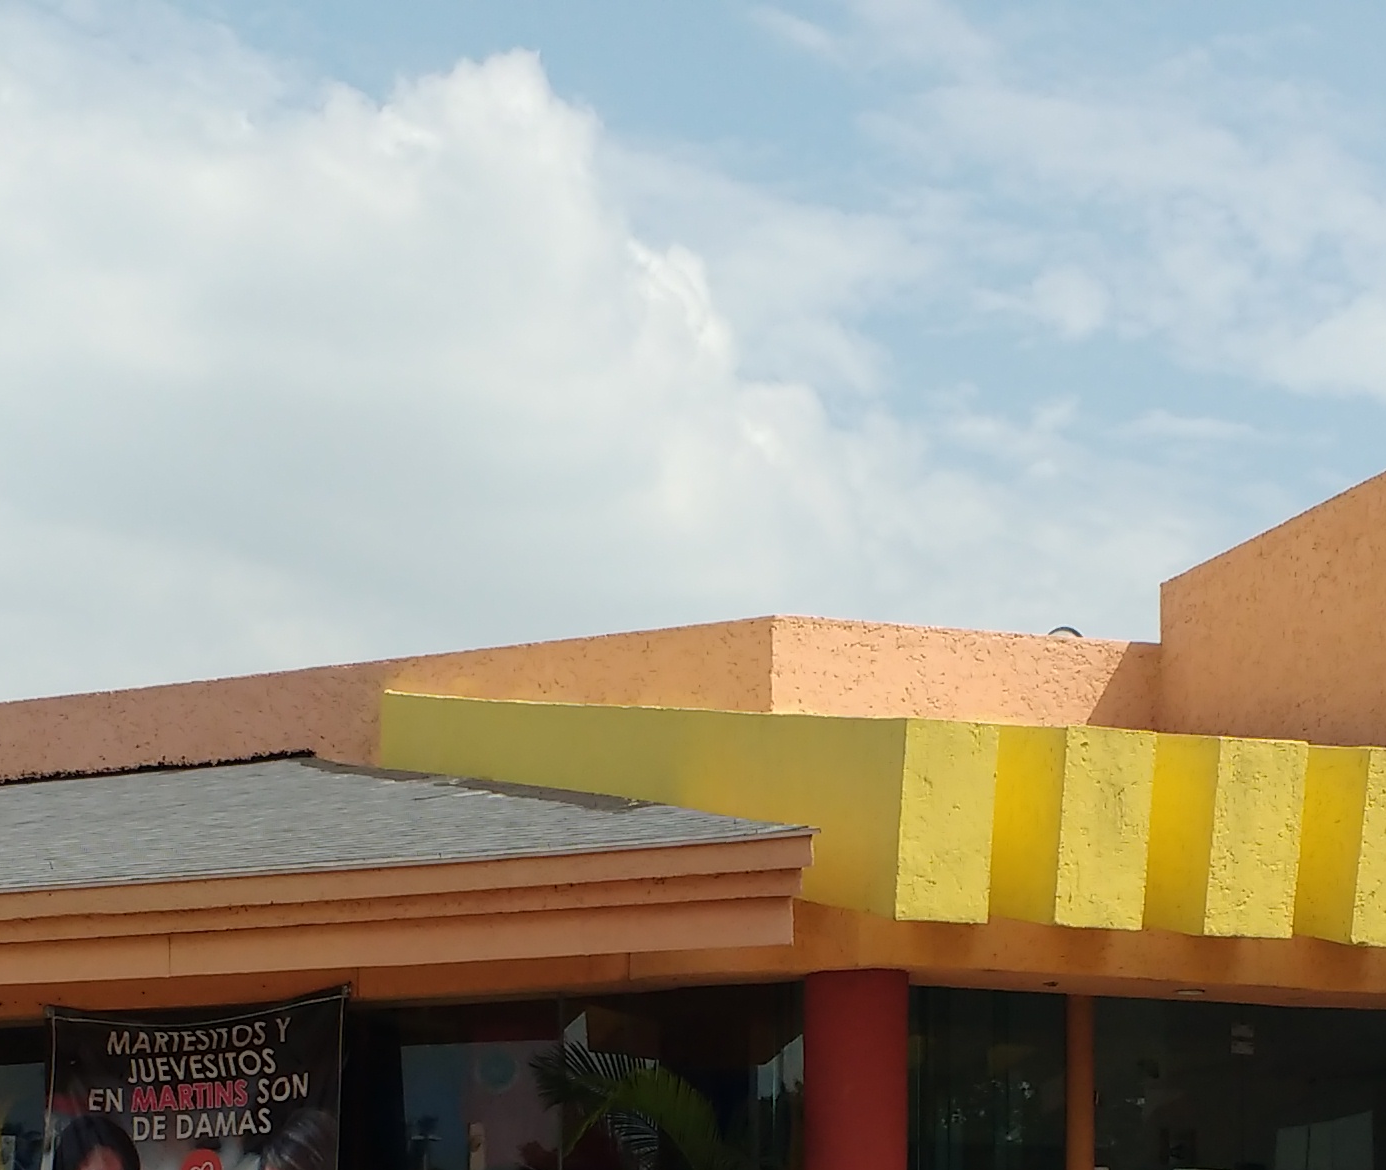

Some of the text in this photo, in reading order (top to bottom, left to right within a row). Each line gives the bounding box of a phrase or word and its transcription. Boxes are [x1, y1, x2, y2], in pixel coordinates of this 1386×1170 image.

[107, 1016, 292, 1056] MARTESITOS Y
[127, 1048, 277, 1084] JUEVESITOS
[88, 1072, 309, 1113] EN MARTINS SON
[132, 1107, 272, 1142] DE DAMAS
